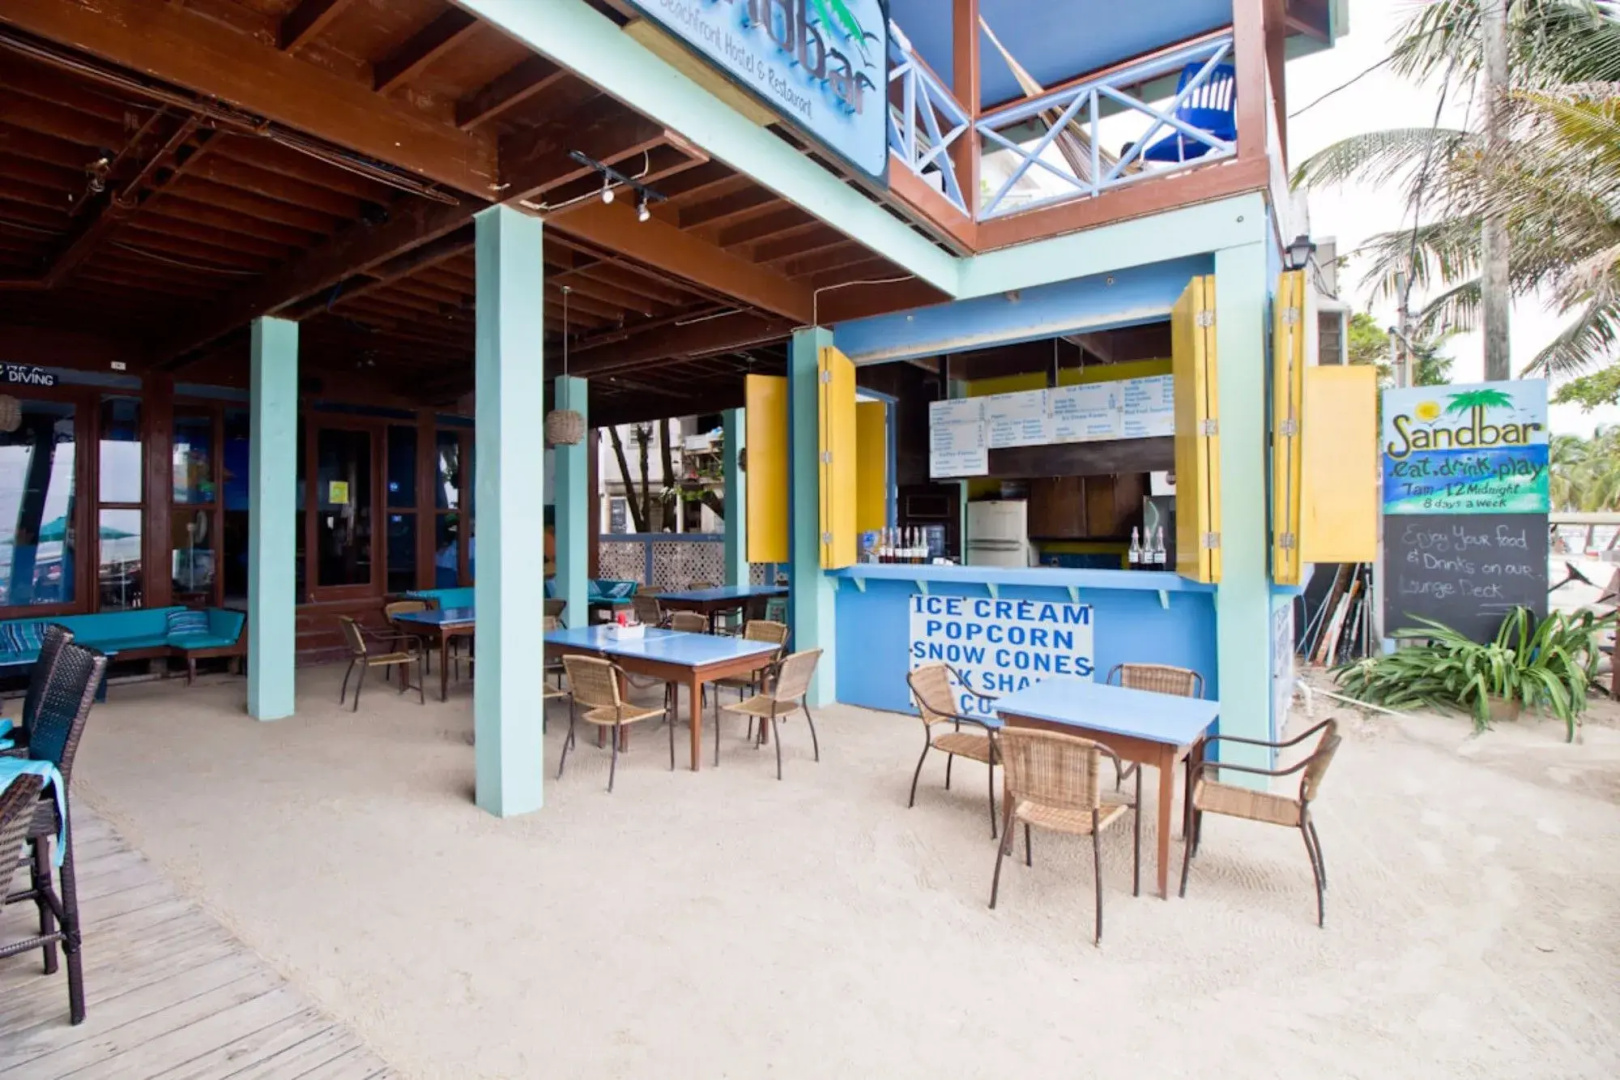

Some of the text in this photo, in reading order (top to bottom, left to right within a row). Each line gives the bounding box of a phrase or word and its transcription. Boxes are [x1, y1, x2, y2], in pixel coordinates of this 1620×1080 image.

[718, 0, 876, 115] dbar
[725, 33, 754, 73] Hostel
[757, 60, 765, 80] &
[768, 66, 812, 119] Restaurant
[9, 371, 54, 386] DIVING
[1387, 404, 1545, 460] Sandbar
[1401, 483, 1434, 496] 7am
[1423, 498, 1432, 508] 8
[1434, 499, 1461, 509] days
[1466, 499, 1473, 508] a
[1401, 524, 1450, 551] Enjoy
[1423, 553, 1475, 574] Drinks
[1482, 563, 1501, 576] on
[1459, 579, 1504, 598] Deck
[914, 596, 1090, 625] ICE CREAM
[926, 620, 1073, 650] POPCORN
[913, 641, 1091, 677] SNOW CONES
[982, 671, 1041, 693] SHA
